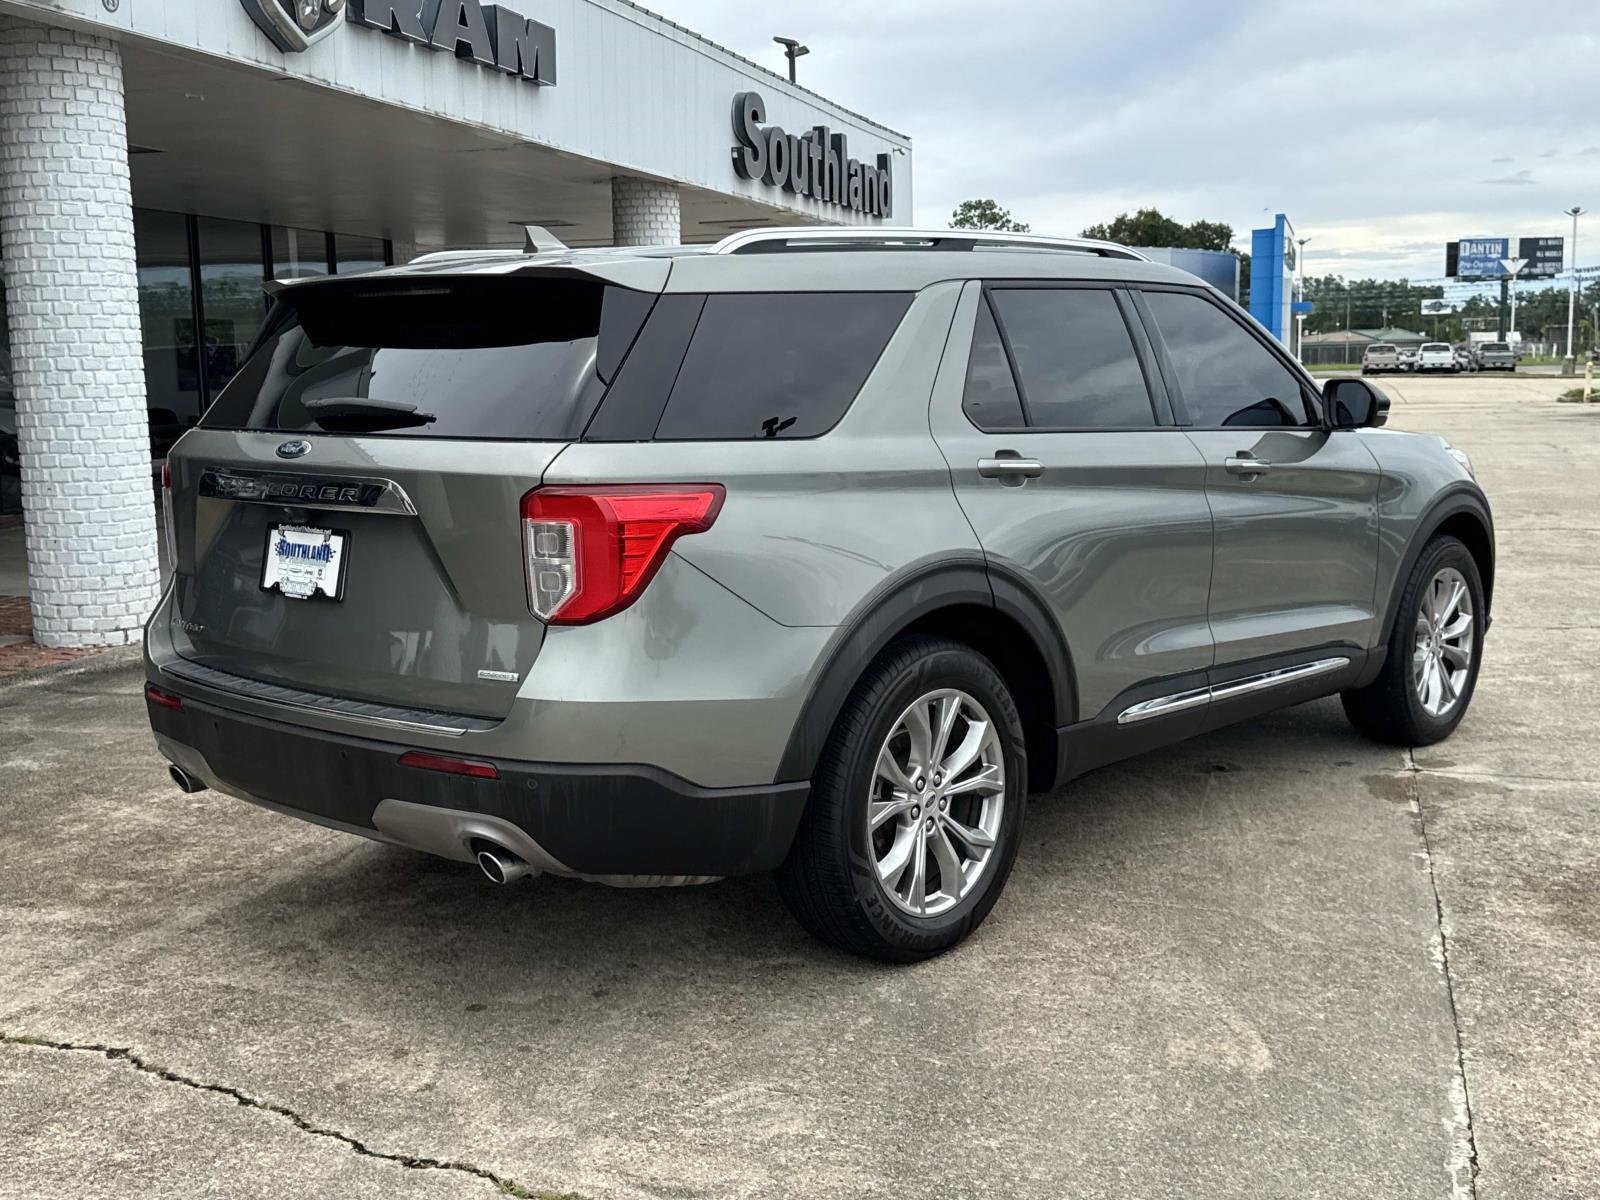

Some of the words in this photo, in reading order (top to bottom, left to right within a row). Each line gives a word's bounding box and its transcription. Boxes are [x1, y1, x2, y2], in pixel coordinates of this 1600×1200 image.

[731, 91, 893, 218] Southland
[1460, 241, 1502, 257] DANTIN
[278, 538, 331, 562] SOUTHLAND
